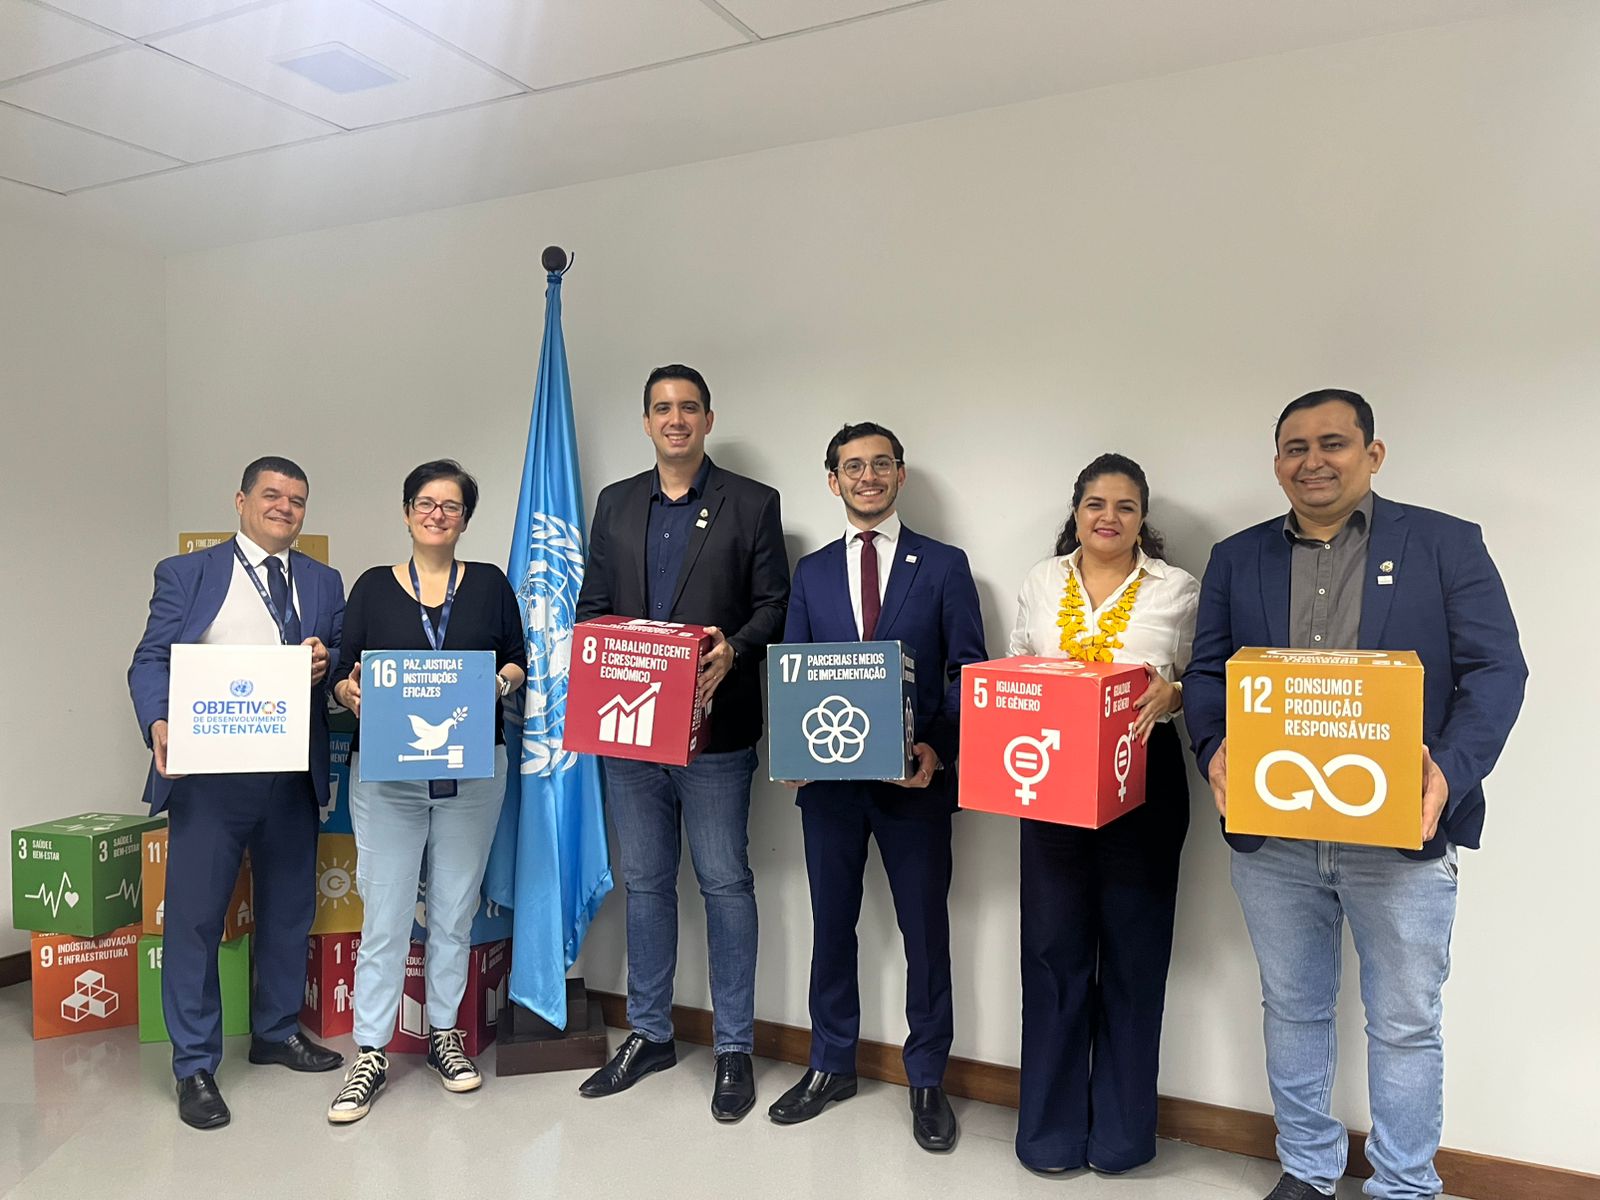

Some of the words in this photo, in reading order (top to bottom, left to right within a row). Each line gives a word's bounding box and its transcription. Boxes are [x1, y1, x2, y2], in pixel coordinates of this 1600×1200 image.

[582, 636, 597, 664] 8
[603, 637, 652, 655] TRABALHO
[652, 643, 691, 660] DECENTE
[403, 659, 422, 670] PAZ,
[422, 659, 457, 671] JUSTIÇA
[457, 659, 463, 670] E
[601, 652, 608, 664] E
[608, 653, 668, 671] CRESCIMENTO
[779, 654, 802, 683] 17
[807, 655, 852, 667] PARCERIAS
[853, 655, 858, 665] E
[858, 653, 885, 665] MEIOS
[371, 659, 397, 688] 16
[403, 671, 458, 685] INSTITUIÇÕES
[600, 667, 651, 683] ECONÔMICO
[807, 669, 819, 681] DE
[819, 667, 887, 681] IMPLEMENTAÇÃO
[403, 686, 441, 698] EFICAZES
[973, 677, 988, 708] 5
[995, 680, 1043, 697] IGUALDADE
[1239, 675, 1273, 714] 12
[1284, 677, 1354, 696] CONSUMO
[1354, 679, 1363, 697] E
[192, 700, 287, 715] OBJETIVOS
[995, 696, 1007, 708] DE
[1007, 697, 1041, 712] GÊNERO
[1104, 685, 1112, 718] 5
[1284, 698, 1363, 719] PRODUÇÃO
[192, 722, 287, 735] SUSTENTÁVEL
[1284, 718, 1391, 741] RESPONSÁVEIS
[18, 837, 28, 860] 3
[32, 839, 49, 850] SAÚDE
[48, 841, 53, 850] E
[99, 840, 109, 862] 3
[147, 841, 161, 864] 11
[32, 850, 60, 861] BEM-ESTAR
[57, 940, 98, 954] INDÚSTRIA,
[98, 934, 137, 950] INOVAÇÃO
[334, 942, 342, 965] 1
[40, 945, 54, 968] 9
[57, 955, 63, 966] E
[63, 948, 129, 965] INFRAESTRUTURA
[405, 967, 424, 977] QUALI
